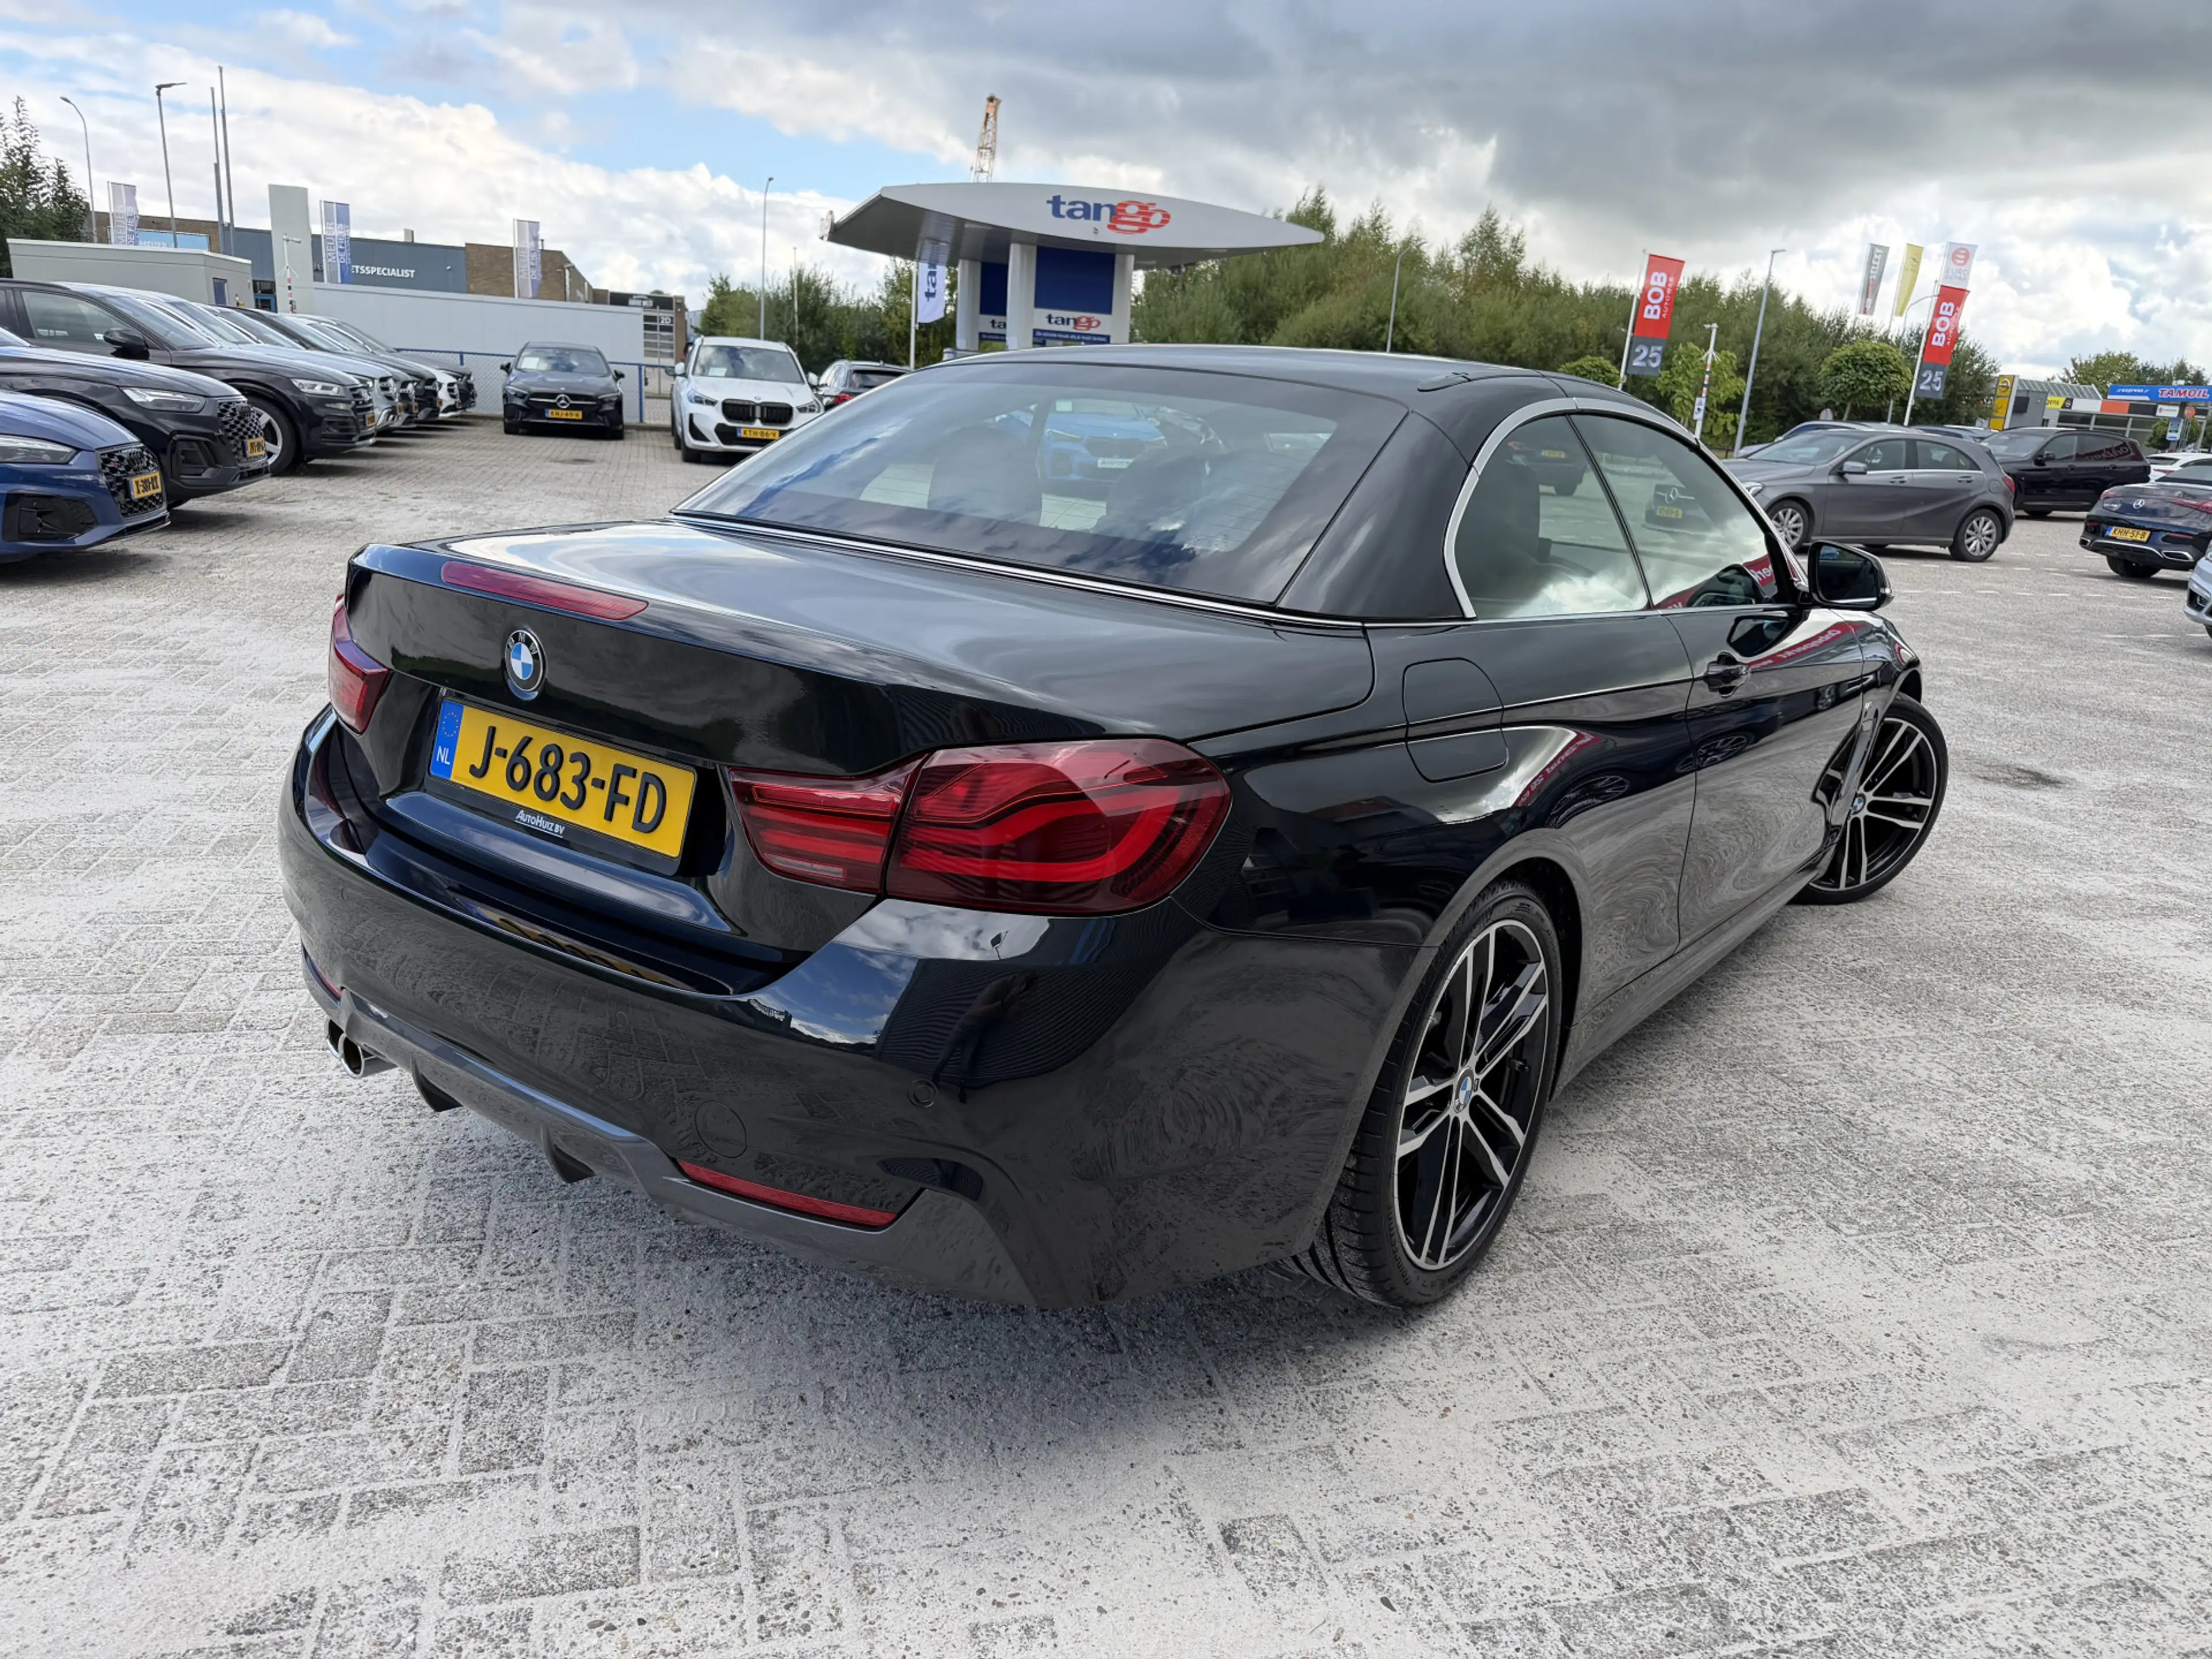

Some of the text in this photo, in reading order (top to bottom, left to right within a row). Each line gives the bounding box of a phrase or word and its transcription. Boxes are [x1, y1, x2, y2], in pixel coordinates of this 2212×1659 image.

[1046, 195, 1171, 234] tango
[1643, 272, 1667, 320] BOB
[1046, 313, 1101, 331] tango
[1931, 301, 1955, 347] BOB
[1632, 344, 1662, 368] 25
[1919, 369, 1944, 392] 25
[2158, 388, 2210, 399] TAMOIL
[436, 746, 450, 766] NL
[469, 725, 667, 834] J-683-FD
